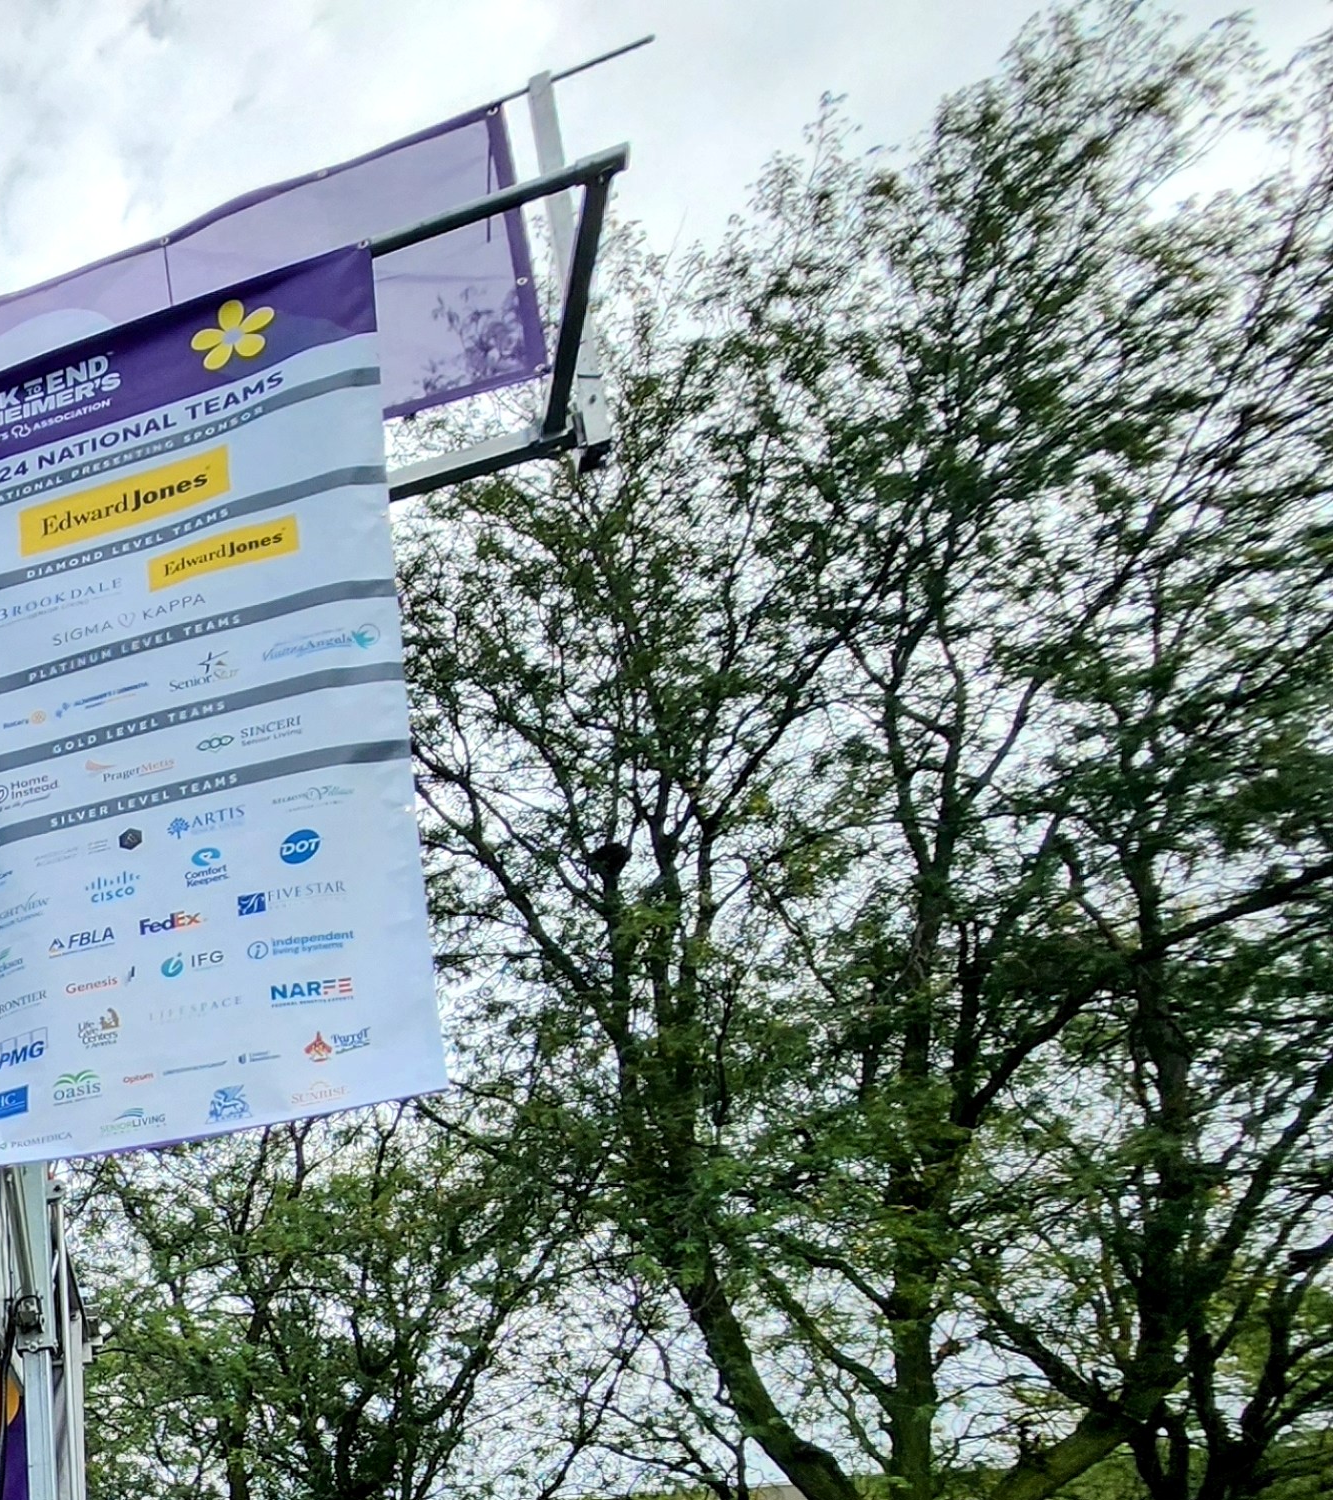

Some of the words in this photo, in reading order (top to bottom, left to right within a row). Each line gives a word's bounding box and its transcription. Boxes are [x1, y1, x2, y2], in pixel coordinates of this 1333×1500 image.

[46, 355, 109, 392] END
[32, 399, 111, 431] ASSOCIATION
[37, 414, 177, 470] NATIONAL
[185, 370, 284, 420] TEAMS
[71, 440, 174, 479] PRESENTING
[183, 406, 264, 443] SPONSOR
[27, 550, 103, 579] DIAMOND
[112, 532, 164, 556] LEVEL
[172, 508, 230, 536] TEAMS
[52, 621, 113, 647] SIGMA
[142, 592, 206, 620] KAPPA
[29, 649, 113, 682] PLATINUM
[121, 631, 174, 655] LEVEL
[183, 614, 241, 637] TEAMS
[52, 733, 97, 754] GOLD
[106, 718, 158, 740] LEVEL
[167, 700, 226, 723] TEAMS
[240, 715, 302, 739] SINCERI
[11, 774, 49, 791] Home
[11, 779, 58, 801] Instead
[50, 805, 109, 828] SILVER
[117, 790, 170, 811] LEVEL
[179, 773, 238, 795] TEAMS
[191, 804, 246, 828] ARTIS
[282, 837, 321, 855] DOT
[184, 864, 227, 881] Comfort
[268, 885, 301, 902] FIVE
[304, 880, 346, 896] STAR
[139, 910, 201, 936] FedEx
[68, 927, 115, 949] FBLA
[272, 930, 354, 948] independent
[191, 950, 224, 968] IFG
[65, 976, 118, 994] Genesis
[53, 1081, 102, 1101] oasis
